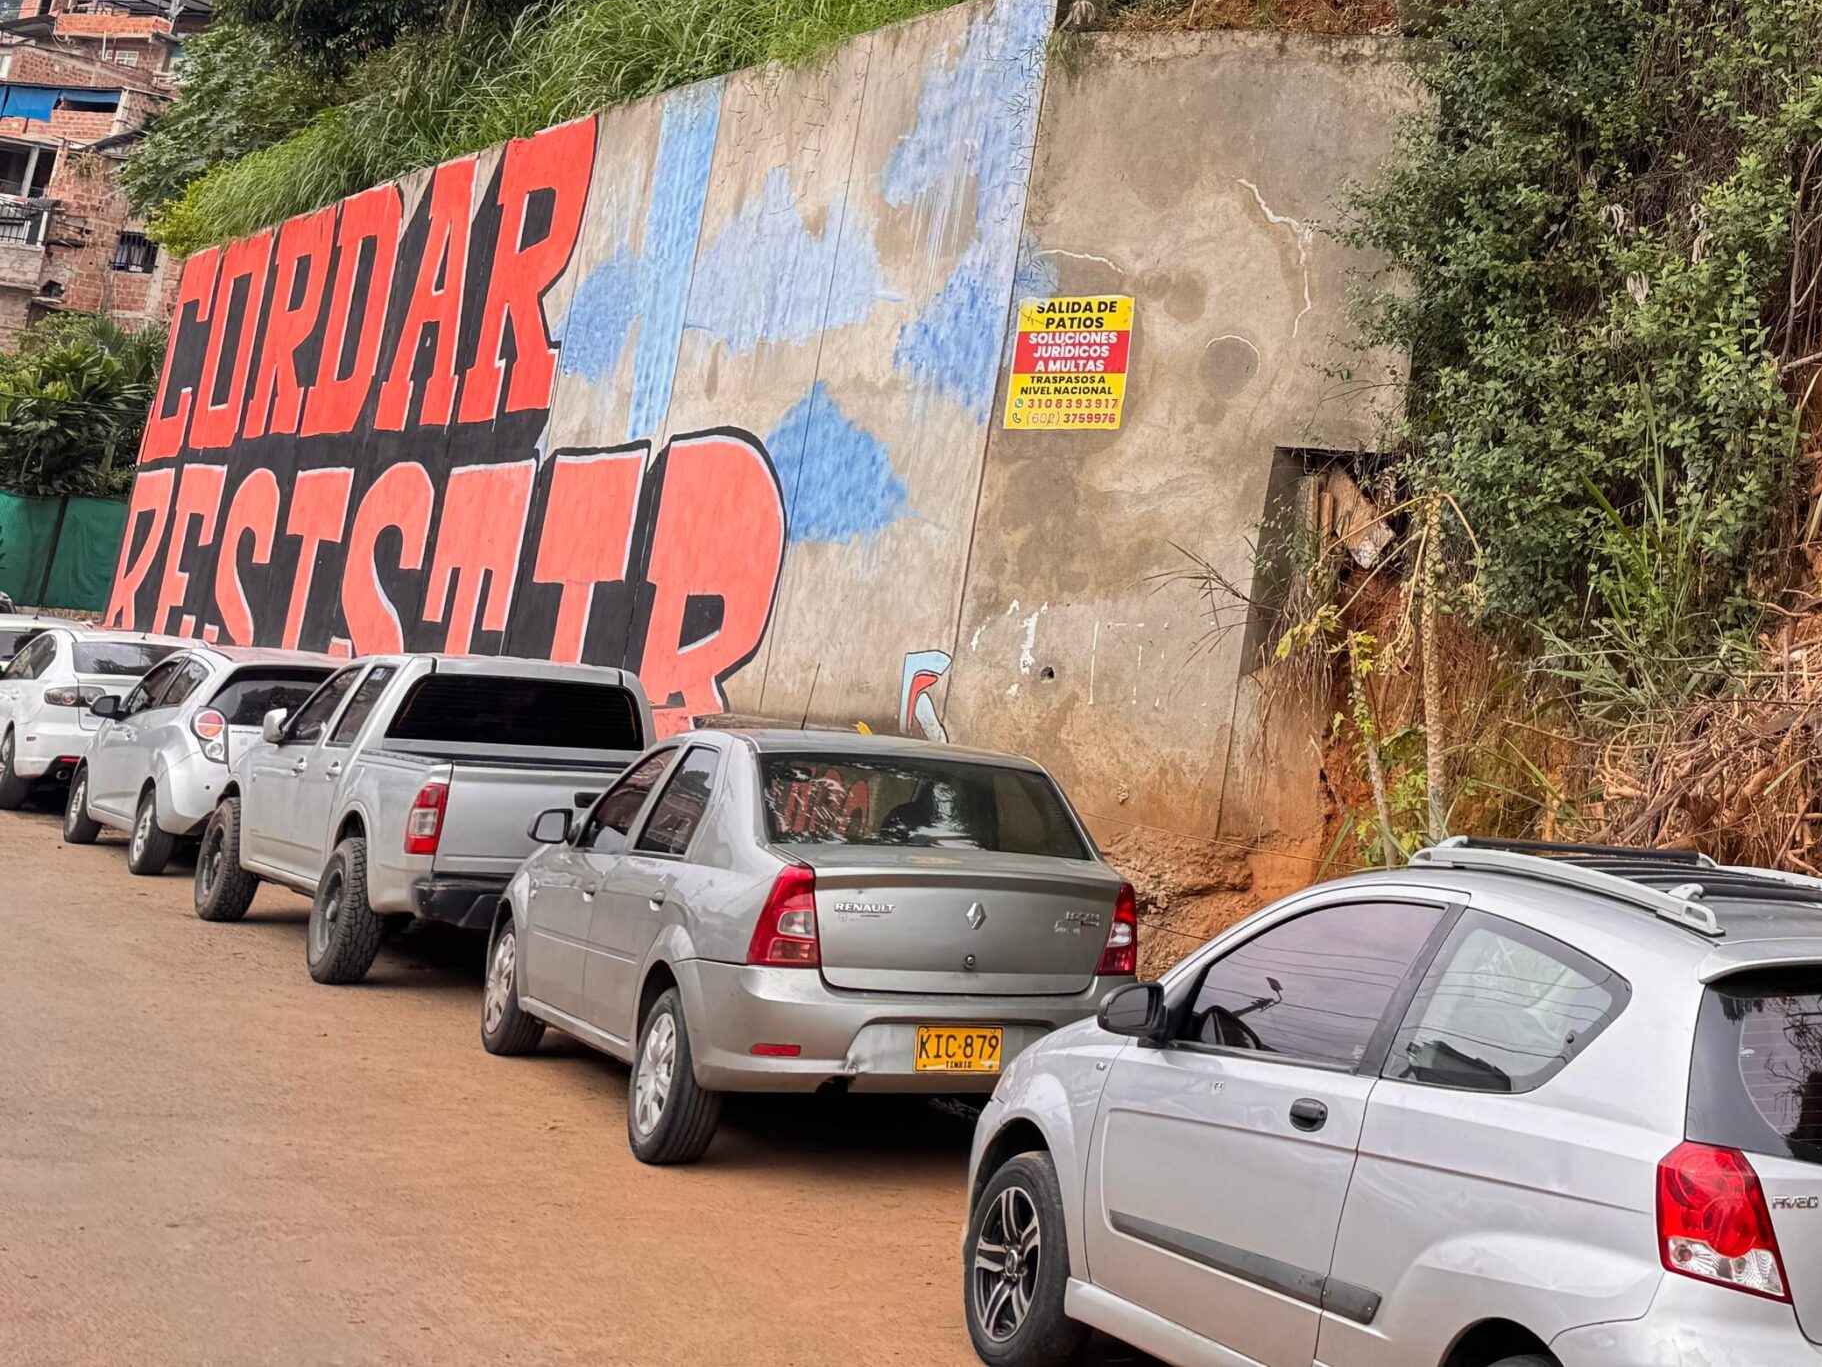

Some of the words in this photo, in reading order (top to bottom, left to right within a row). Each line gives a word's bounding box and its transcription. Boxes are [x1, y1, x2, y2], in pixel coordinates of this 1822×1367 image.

[137, 117, 597, 465] CORDAR
[1036, 301, 1094, 314] SALIDA
[1097, 301, 1117, 313] DE
[1045, 317, 1104, 329] PATIOS
[1029, 332, 1118, 344] SOLUCIONES
[1033, 342, 1110, 358] JURÍDICOS
[1035, 361, 1046, 372] A
[1048, 360, 1105, 372] MULTAS
[1030, 375, 1096, 384] TRASPASOS
[1097, 376, 1106, 384] A
[1020, 386, 1051, 395] NIVEL
[1053, 386, 1113, 395] NACIONAL
[1063, 413, 1116, 423] 3759976
[835, 903, 895, 913] RENAULT
